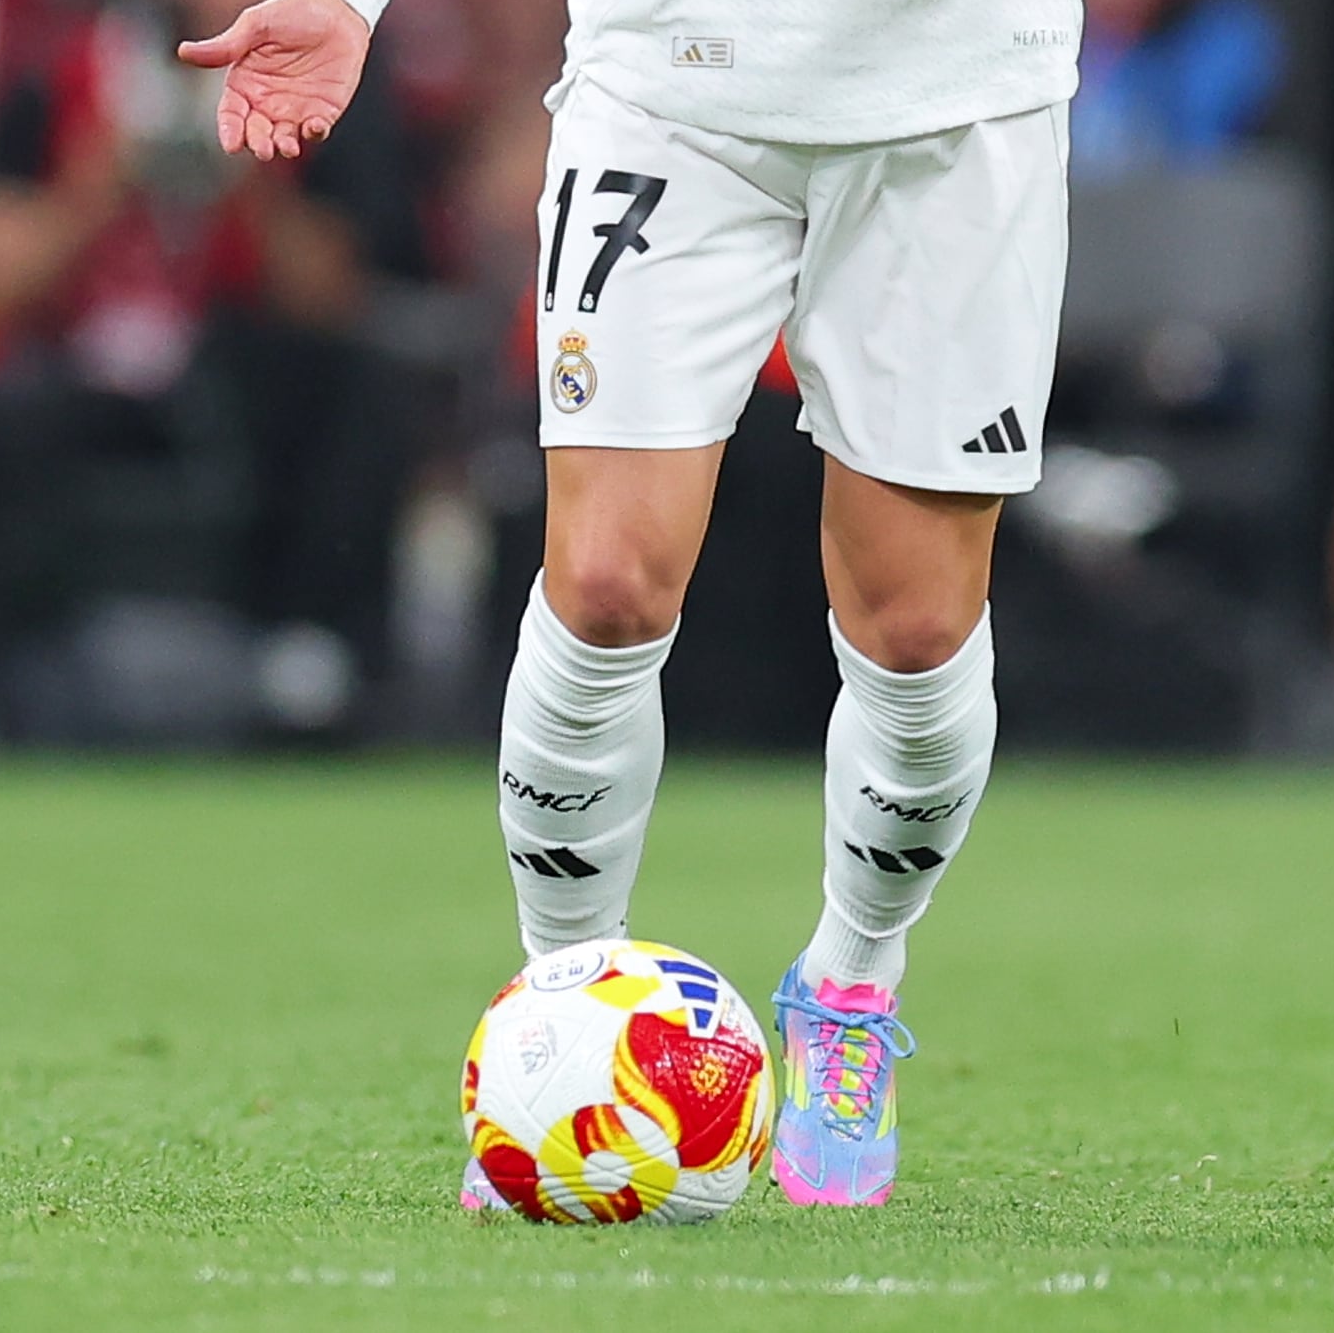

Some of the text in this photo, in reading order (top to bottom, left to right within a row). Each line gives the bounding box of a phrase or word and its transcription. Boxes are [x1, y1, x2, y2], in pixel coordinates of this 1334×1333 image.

[545, 169, 668, 313] 17
[503, 771, 612, 812] RMCF
[860, 785, 973, 822] RMCF
